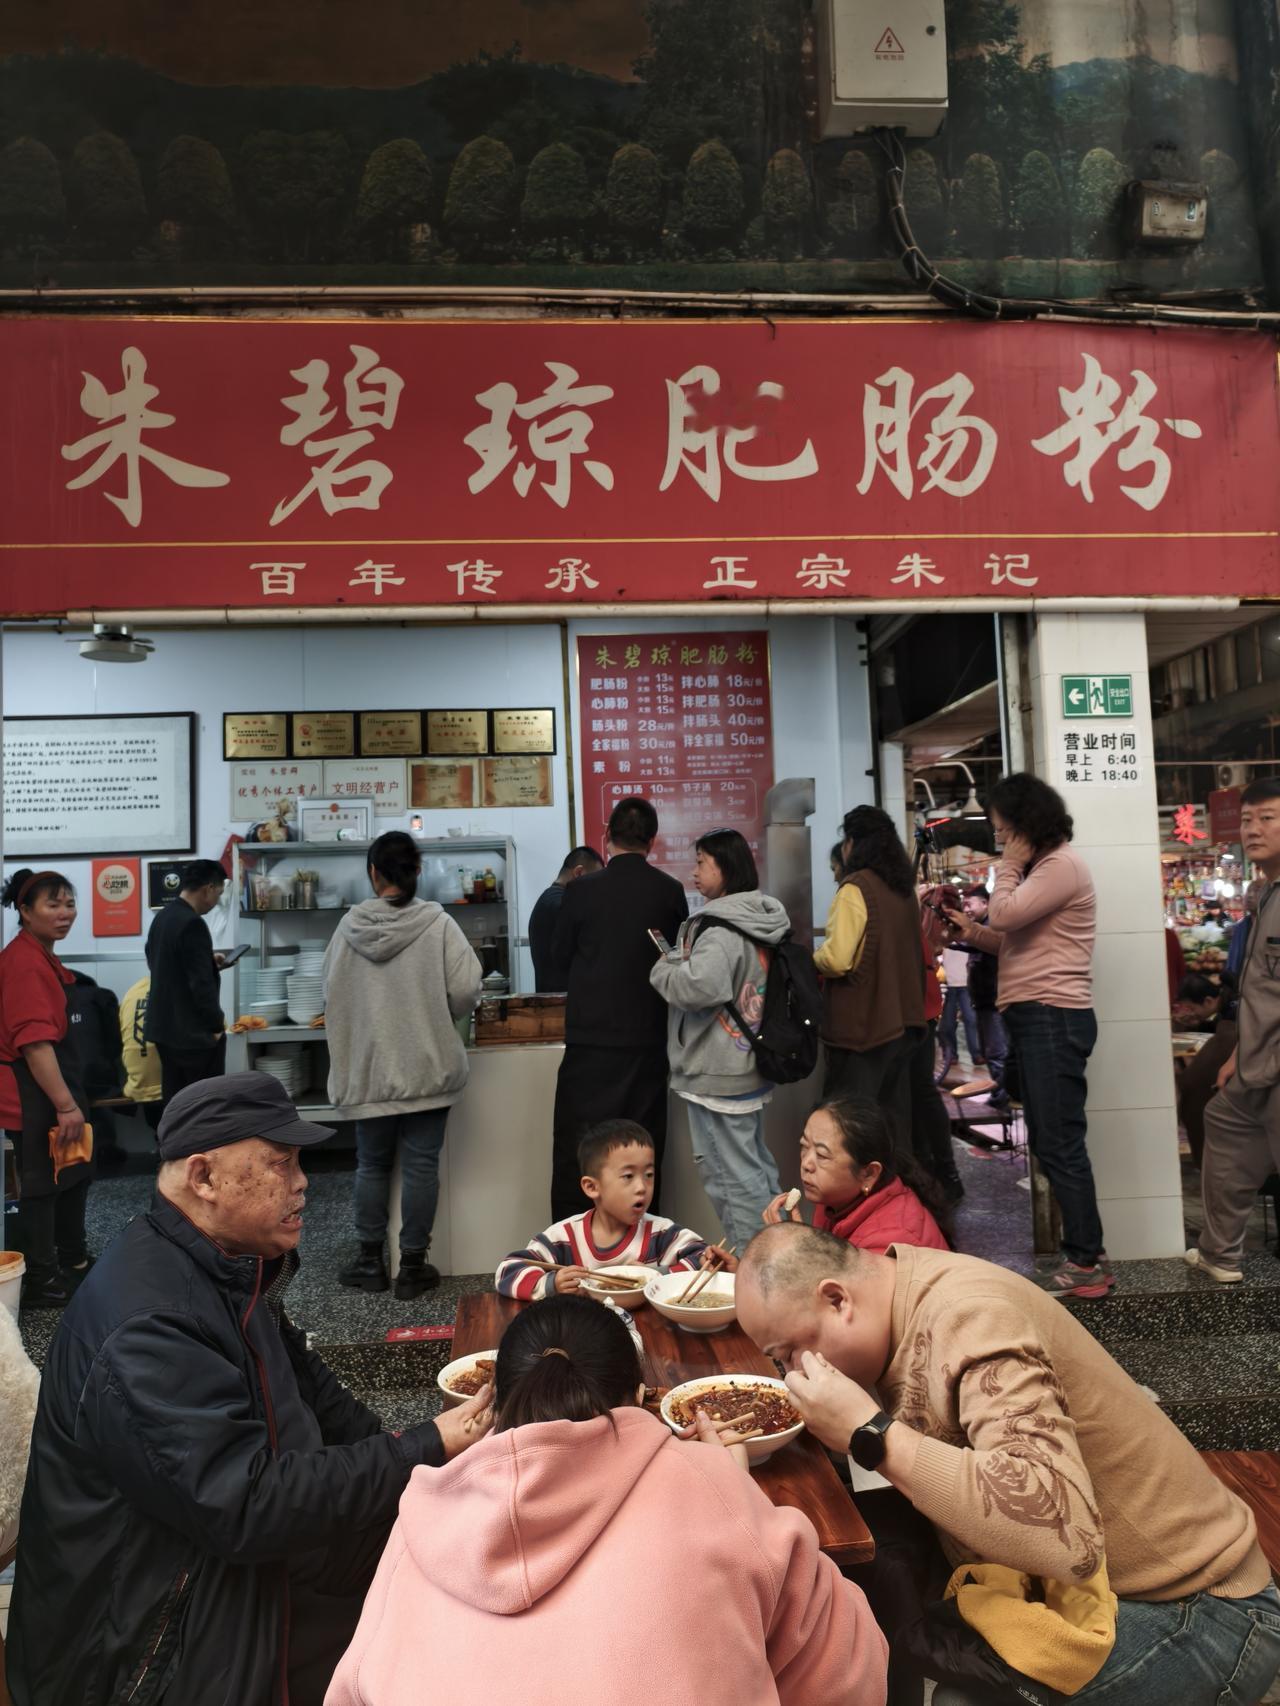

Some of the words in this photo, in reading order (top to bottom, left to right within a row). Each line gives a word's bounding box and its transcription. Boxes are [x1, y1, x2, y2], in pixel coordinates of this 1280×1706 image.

[249, 558, 600, 596] 百年传承
[702, 553, 1039, 590] 正宗朱记
[595, 642, 759, 669] 朱碧琼肥肠粉
[1064, 732, 1136, 751] 营业时间
[1065, 754, 1093, 766] 早上
[1107, 754, 1137, 765] 6:40
[1065, 769, 1093, 782] 晚上
[1101, 769, 1138, 781] 18:40
[238, 783, 317, 798] 优秀个体工商户
[333, 781, 400, 796] 文明经营户
[1173, 803, 1208, 846] 菜
